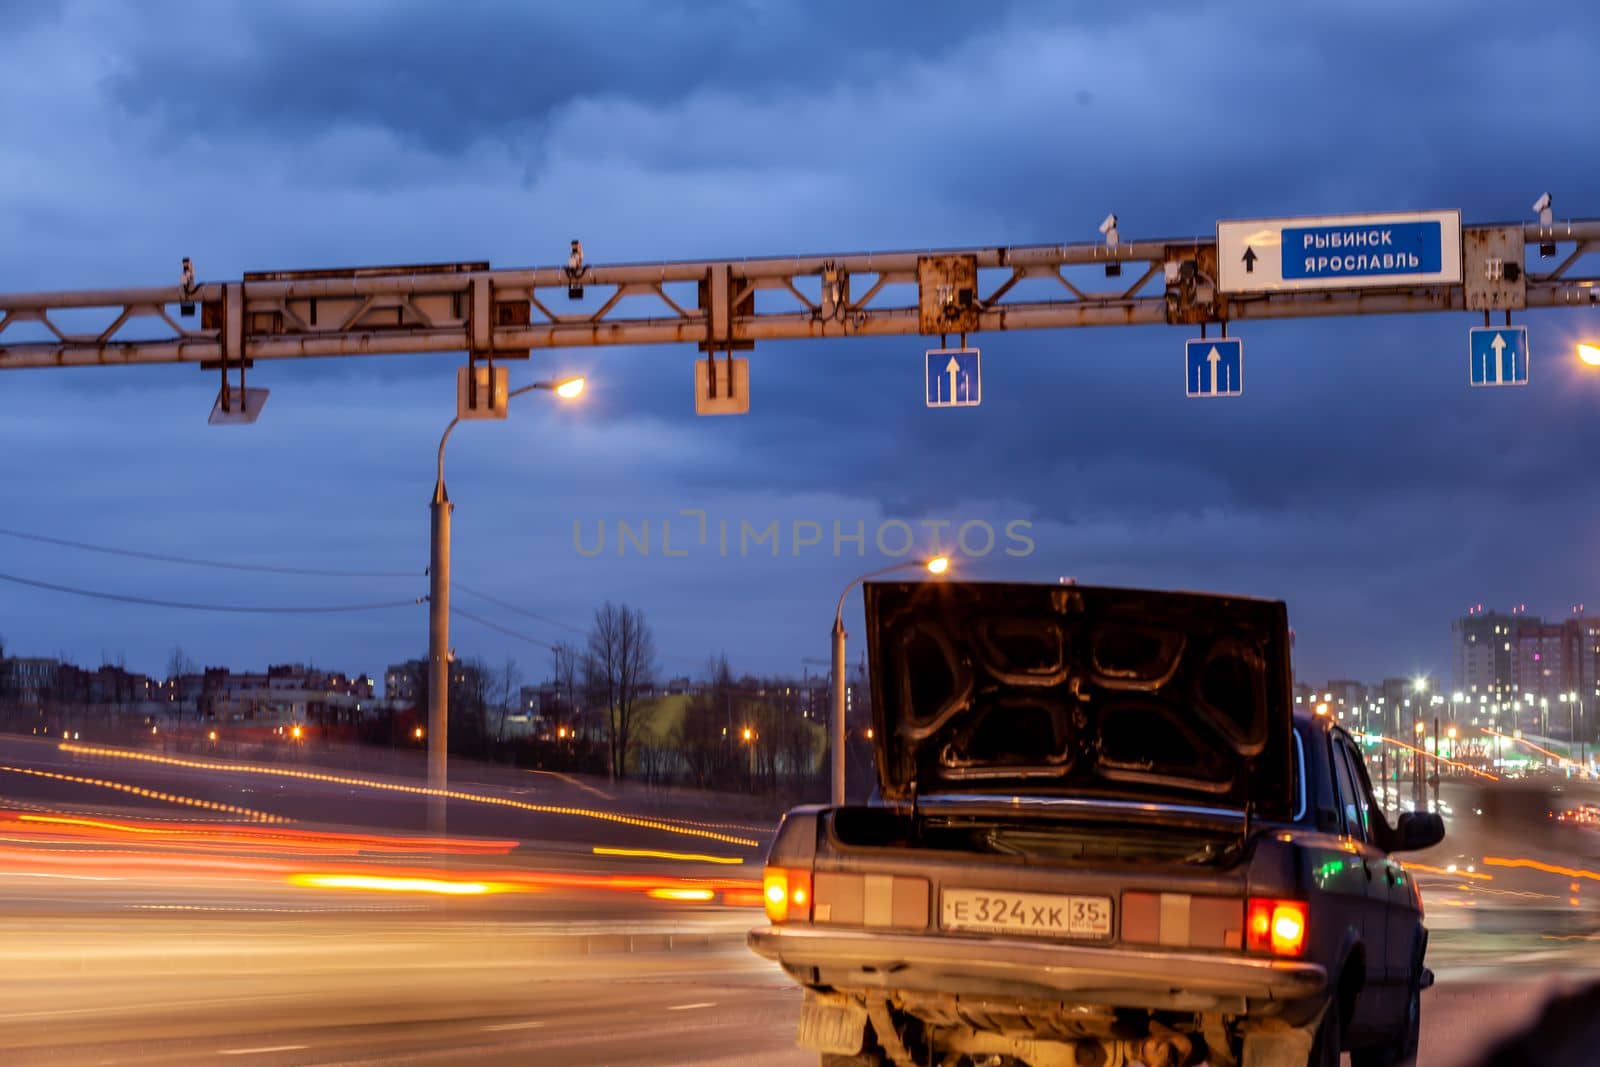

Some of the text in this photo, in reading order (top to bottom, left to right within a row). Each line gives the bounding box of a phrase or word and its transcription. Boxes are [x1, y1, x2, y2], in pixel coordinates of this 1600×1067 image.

[1303, 230, 1393, 249] РЫБИНСК
[1304, 252, 1420, 273] ЯРОСЛАВЛЬ
[1073, 901, 1100, 922] 35
